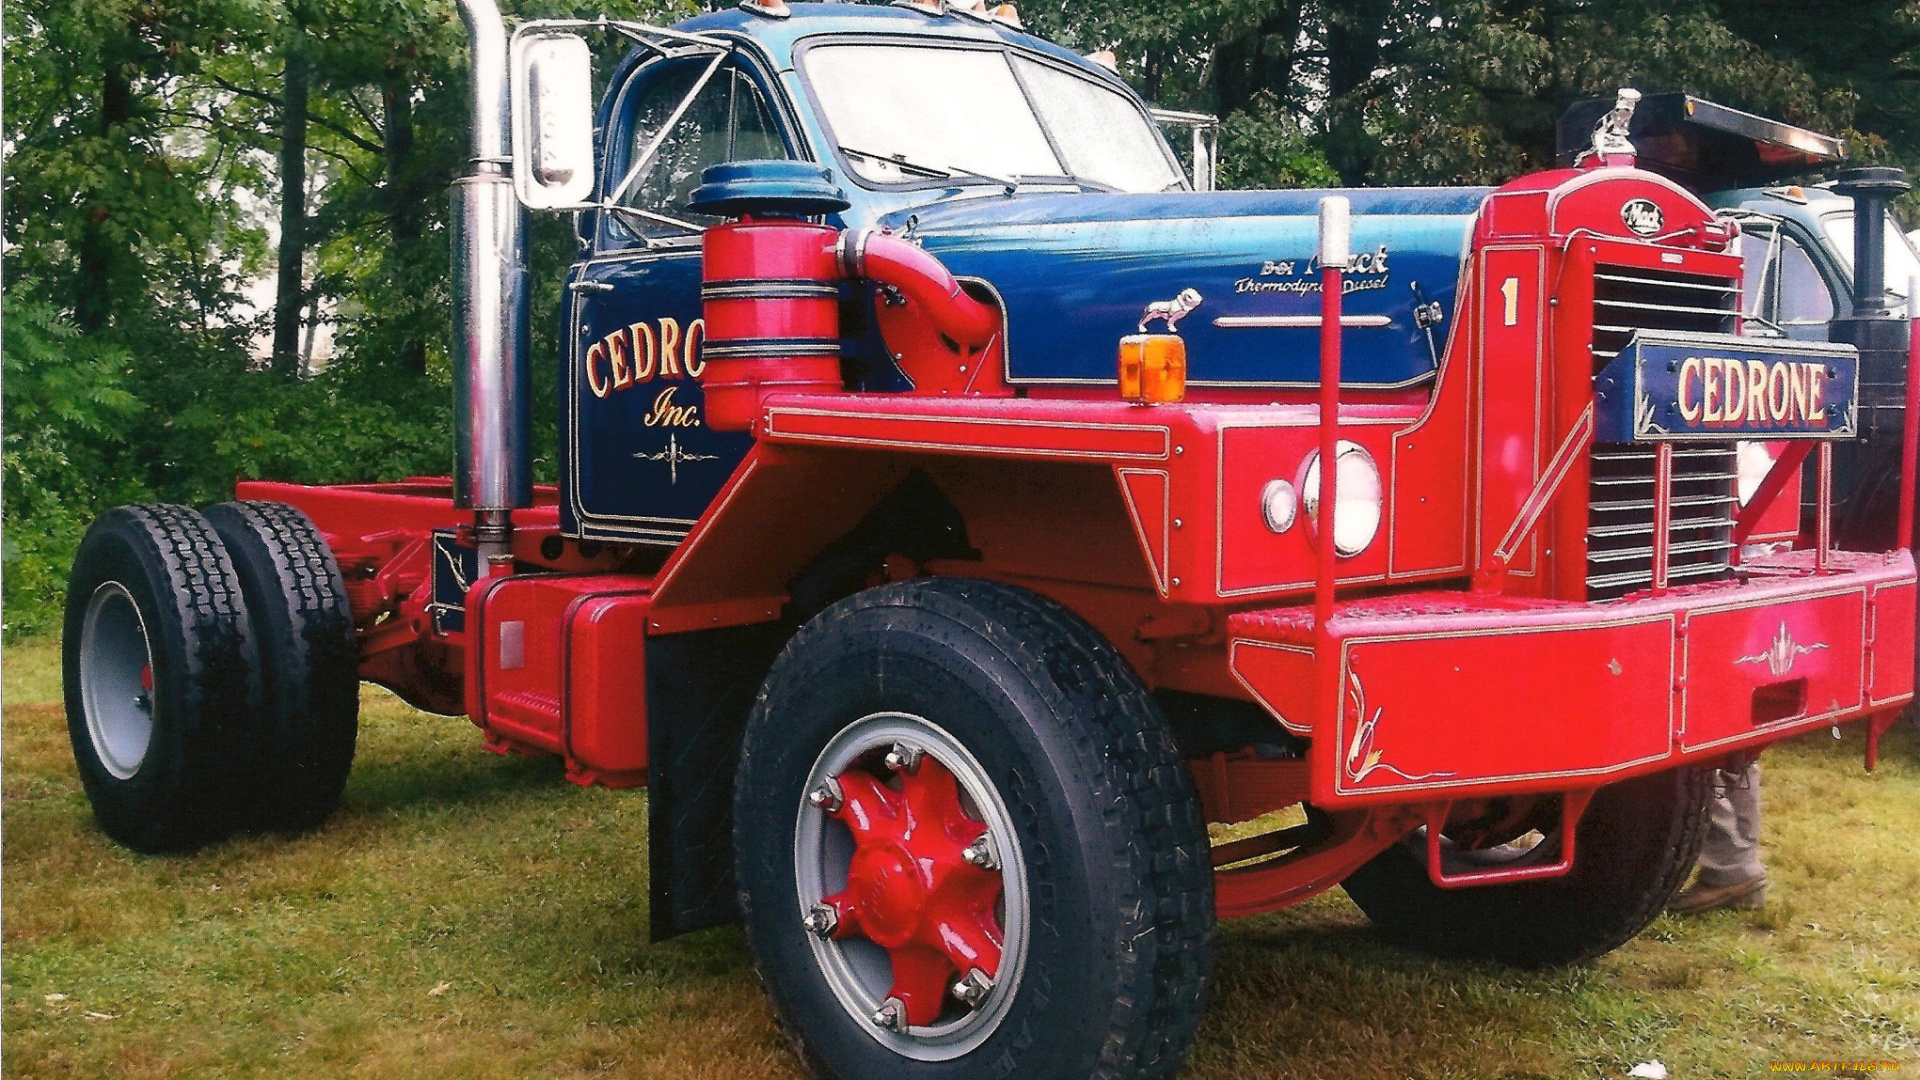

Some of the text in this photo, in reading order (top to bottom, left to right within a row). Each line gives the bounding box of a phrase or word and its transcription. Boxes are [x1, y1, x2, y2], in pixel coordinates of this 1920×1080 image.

[1341, 275, 1388, 295] Diesel
[1501, 277, 1519, 326] 1
[644, 386, 700, 427] Inc.
[1678, 356, 1827, 426] CEDRONE
